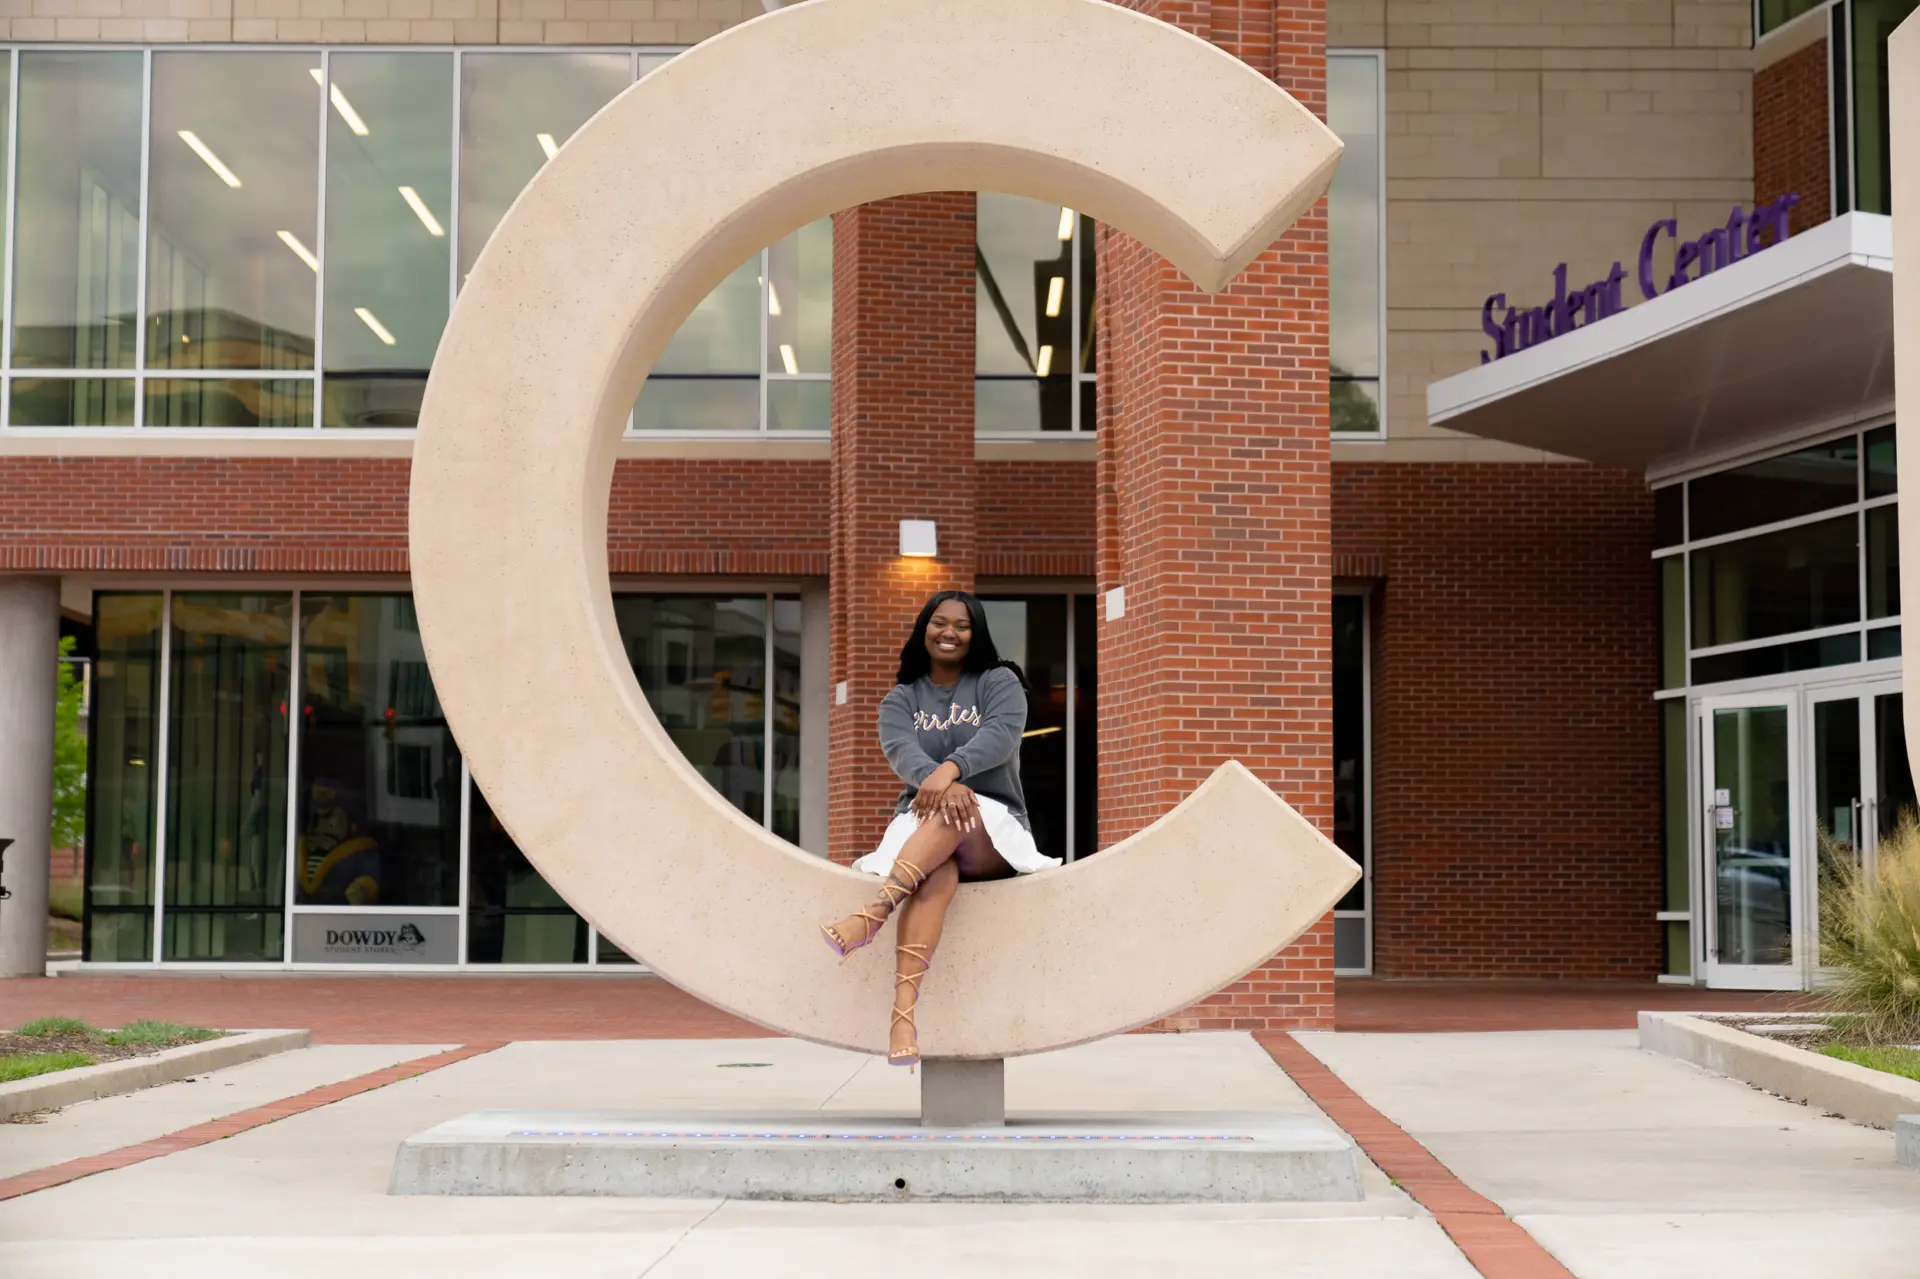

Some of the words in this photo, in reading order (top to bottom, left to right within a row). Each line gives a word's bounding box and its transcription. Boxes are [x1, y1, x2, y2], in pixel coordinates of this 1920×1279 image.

[1481, 262, 1629, 365] Student
[1638, 192, 1799, 300] Center
[325, 930, 397, 945] DOWDY
